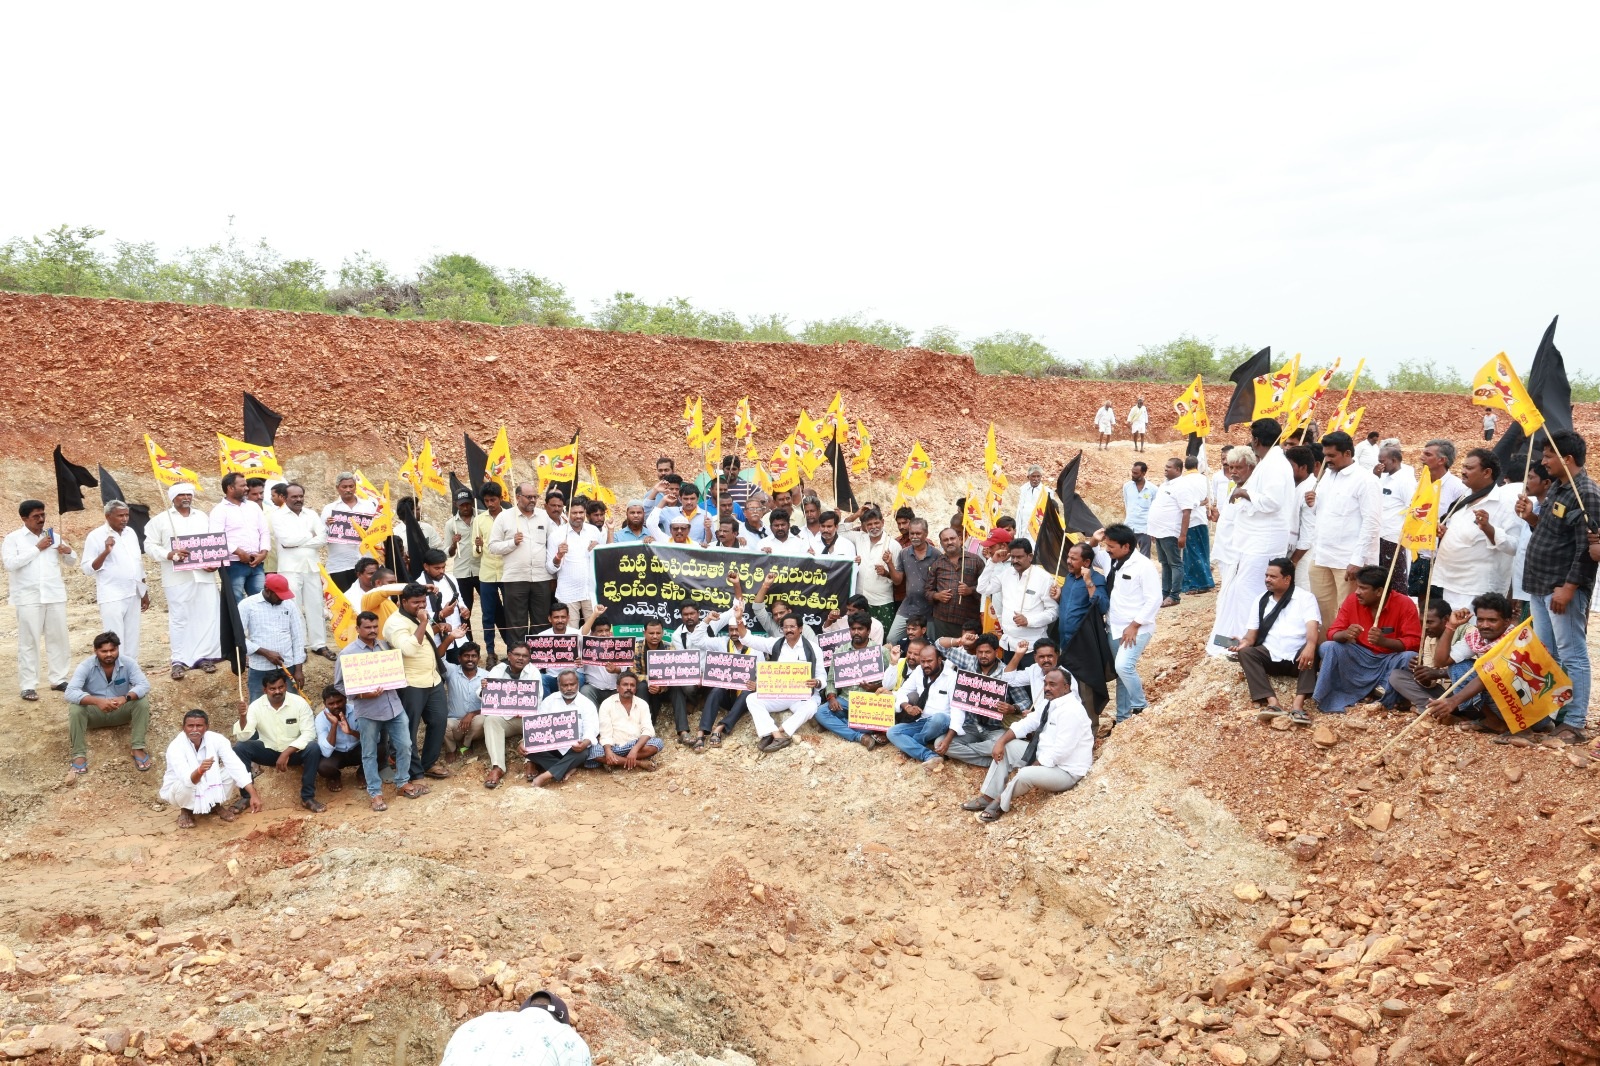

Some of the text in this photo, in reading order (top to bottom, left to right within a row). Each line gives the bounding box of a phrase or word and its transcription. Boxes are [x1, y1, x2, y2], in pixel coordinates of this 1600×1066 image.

[619, 554, 647, 579] మట్టి
[650, 555, 724, 578] మాఫియాతో
[604, 581, 657, 602] ధ్వంసం
[661, 581, 685, 600] చేసి
[691, 587, 731, 608] కోట్లు
[623, 602, 671, 624] ఎమ్మెల్యే
[1491, 672, 1526, 729] తెలుగుదేశం
